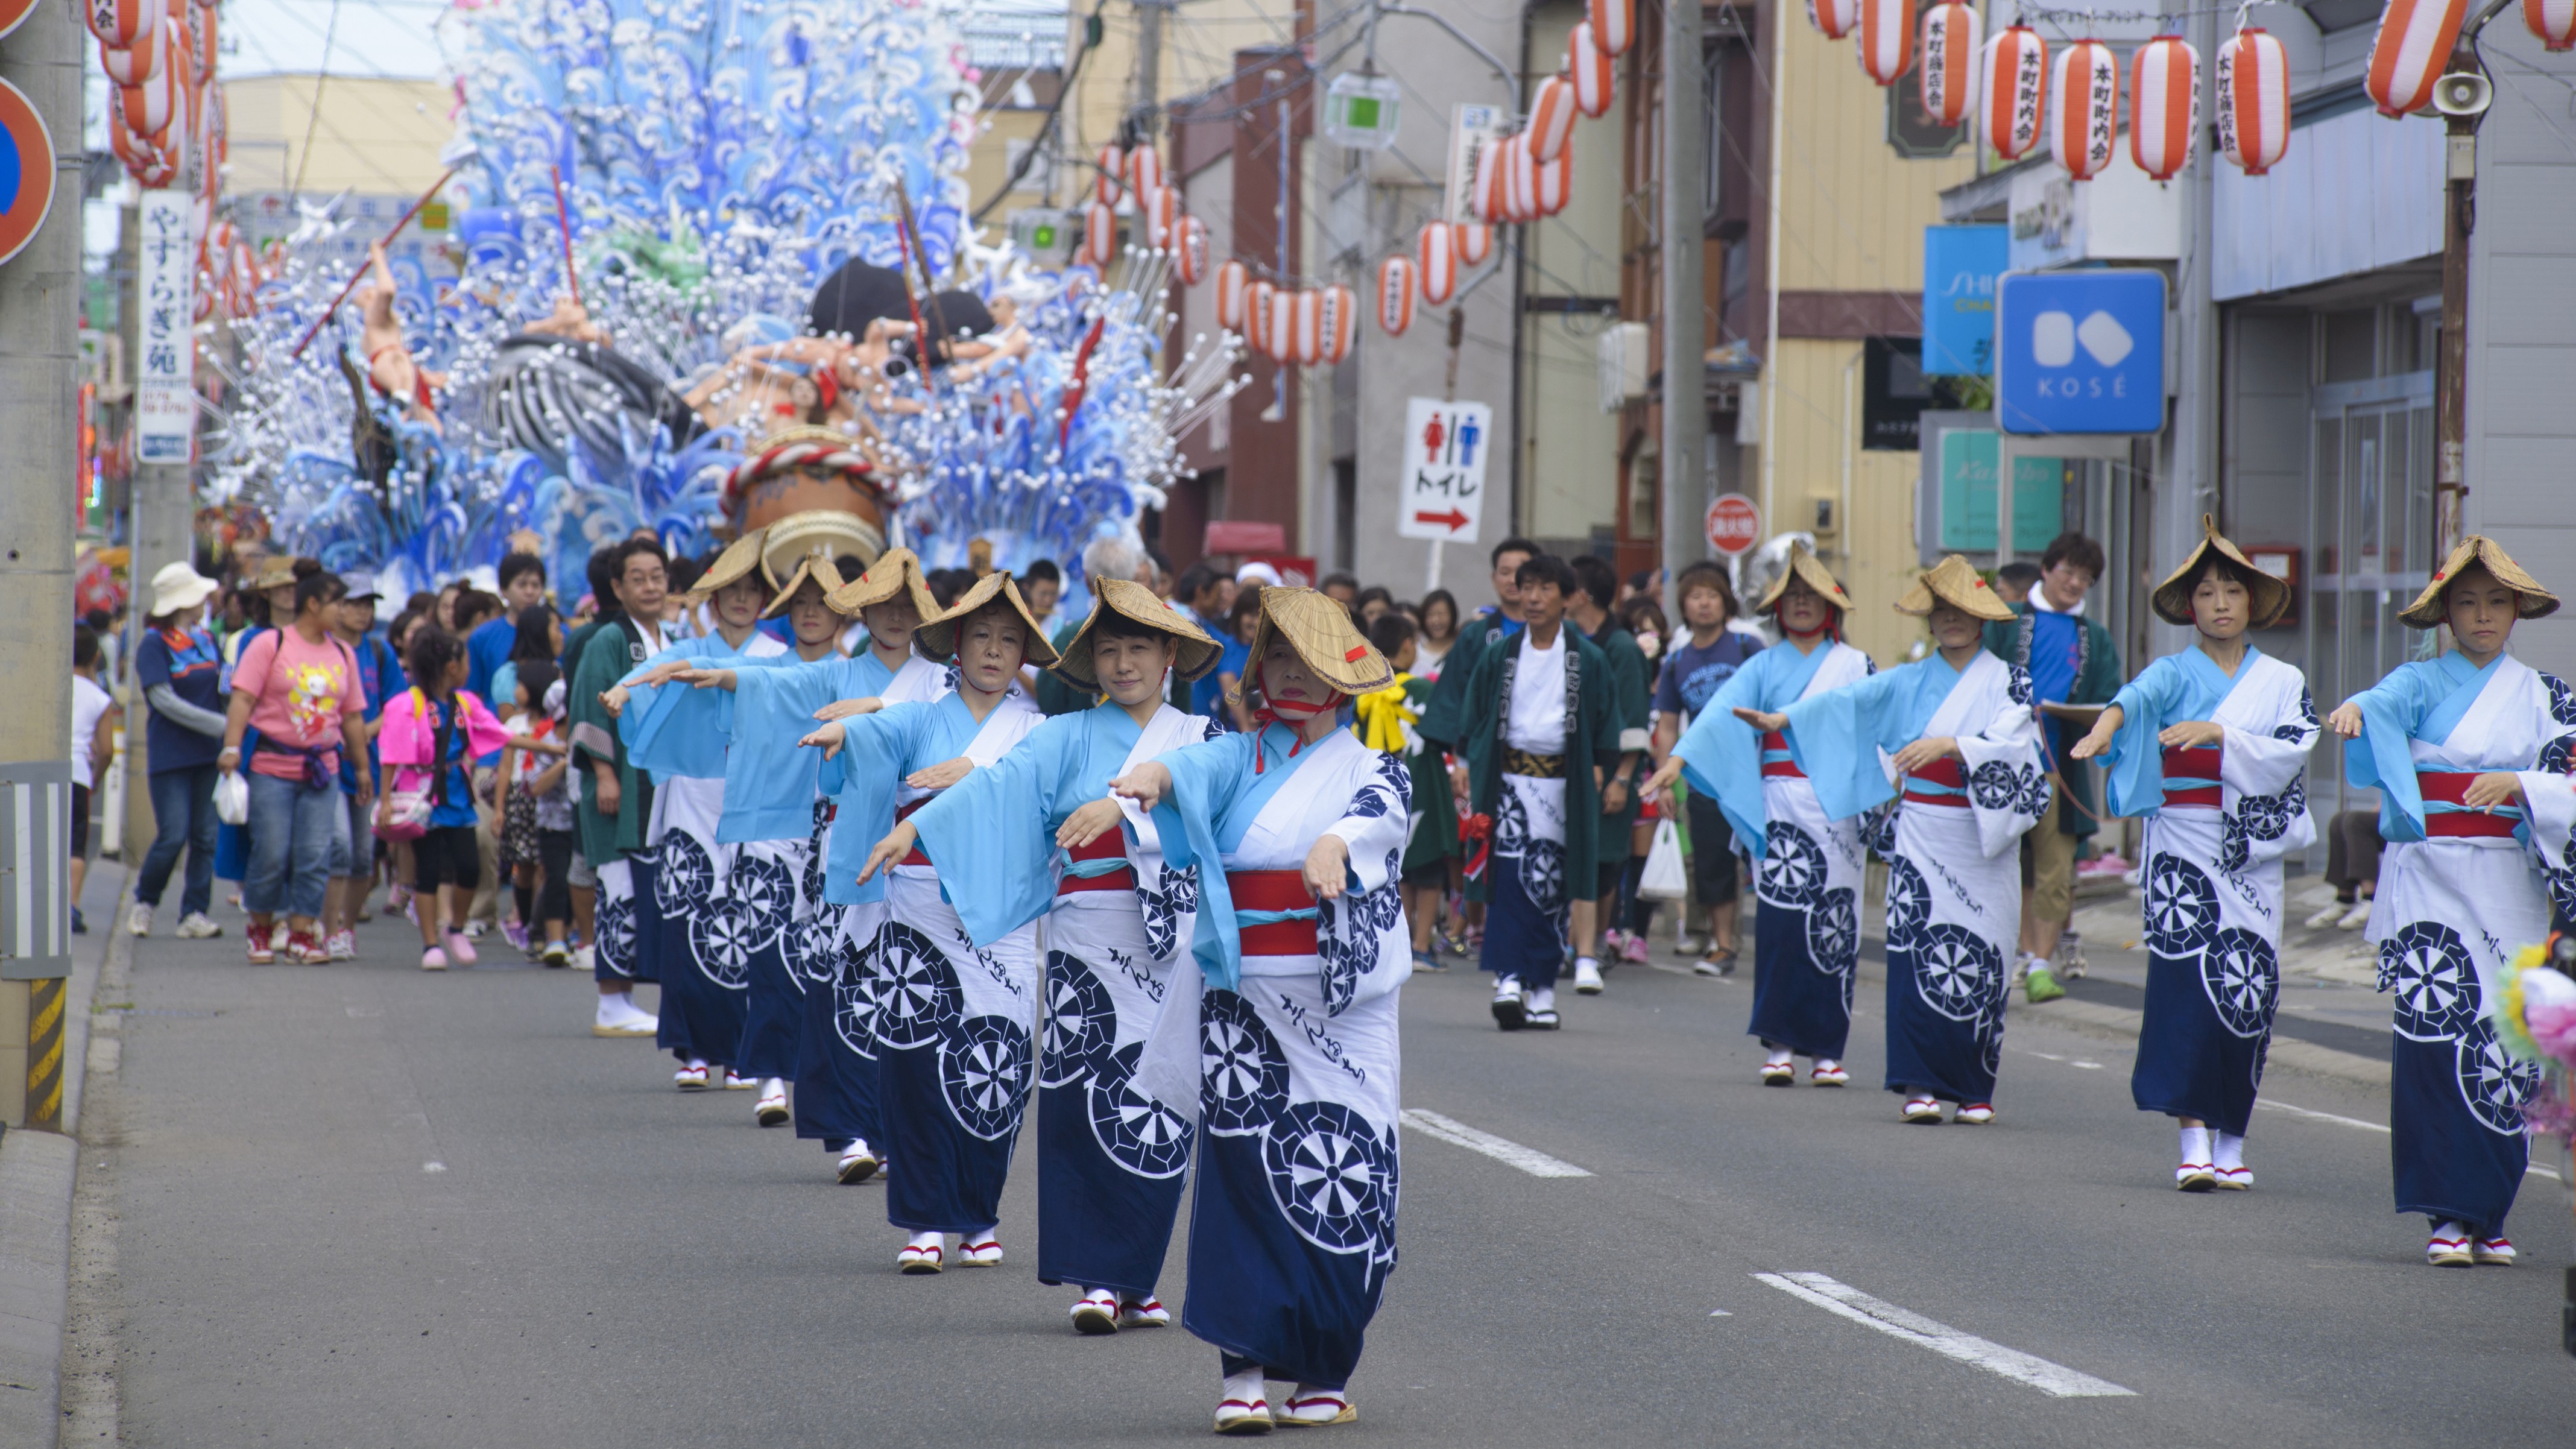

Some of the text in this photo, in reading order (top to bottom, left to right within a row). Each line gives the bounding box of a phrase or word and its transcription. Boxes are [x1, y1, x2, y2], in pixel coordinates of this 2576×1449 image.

[1928, 19, 1945, 107] 本町商店会
[2015, 48, 2040, 140] 本町町内会
[2218, 54, 2237, 153] 本町商店会
[2090, 63, 2112, 160] 本町町内会
[147, 206, 178, 374] やすらぎ苑
[2037, 373, 2127, 399] KOSÉ
[1416, 468, 1477, 499] トイレ
